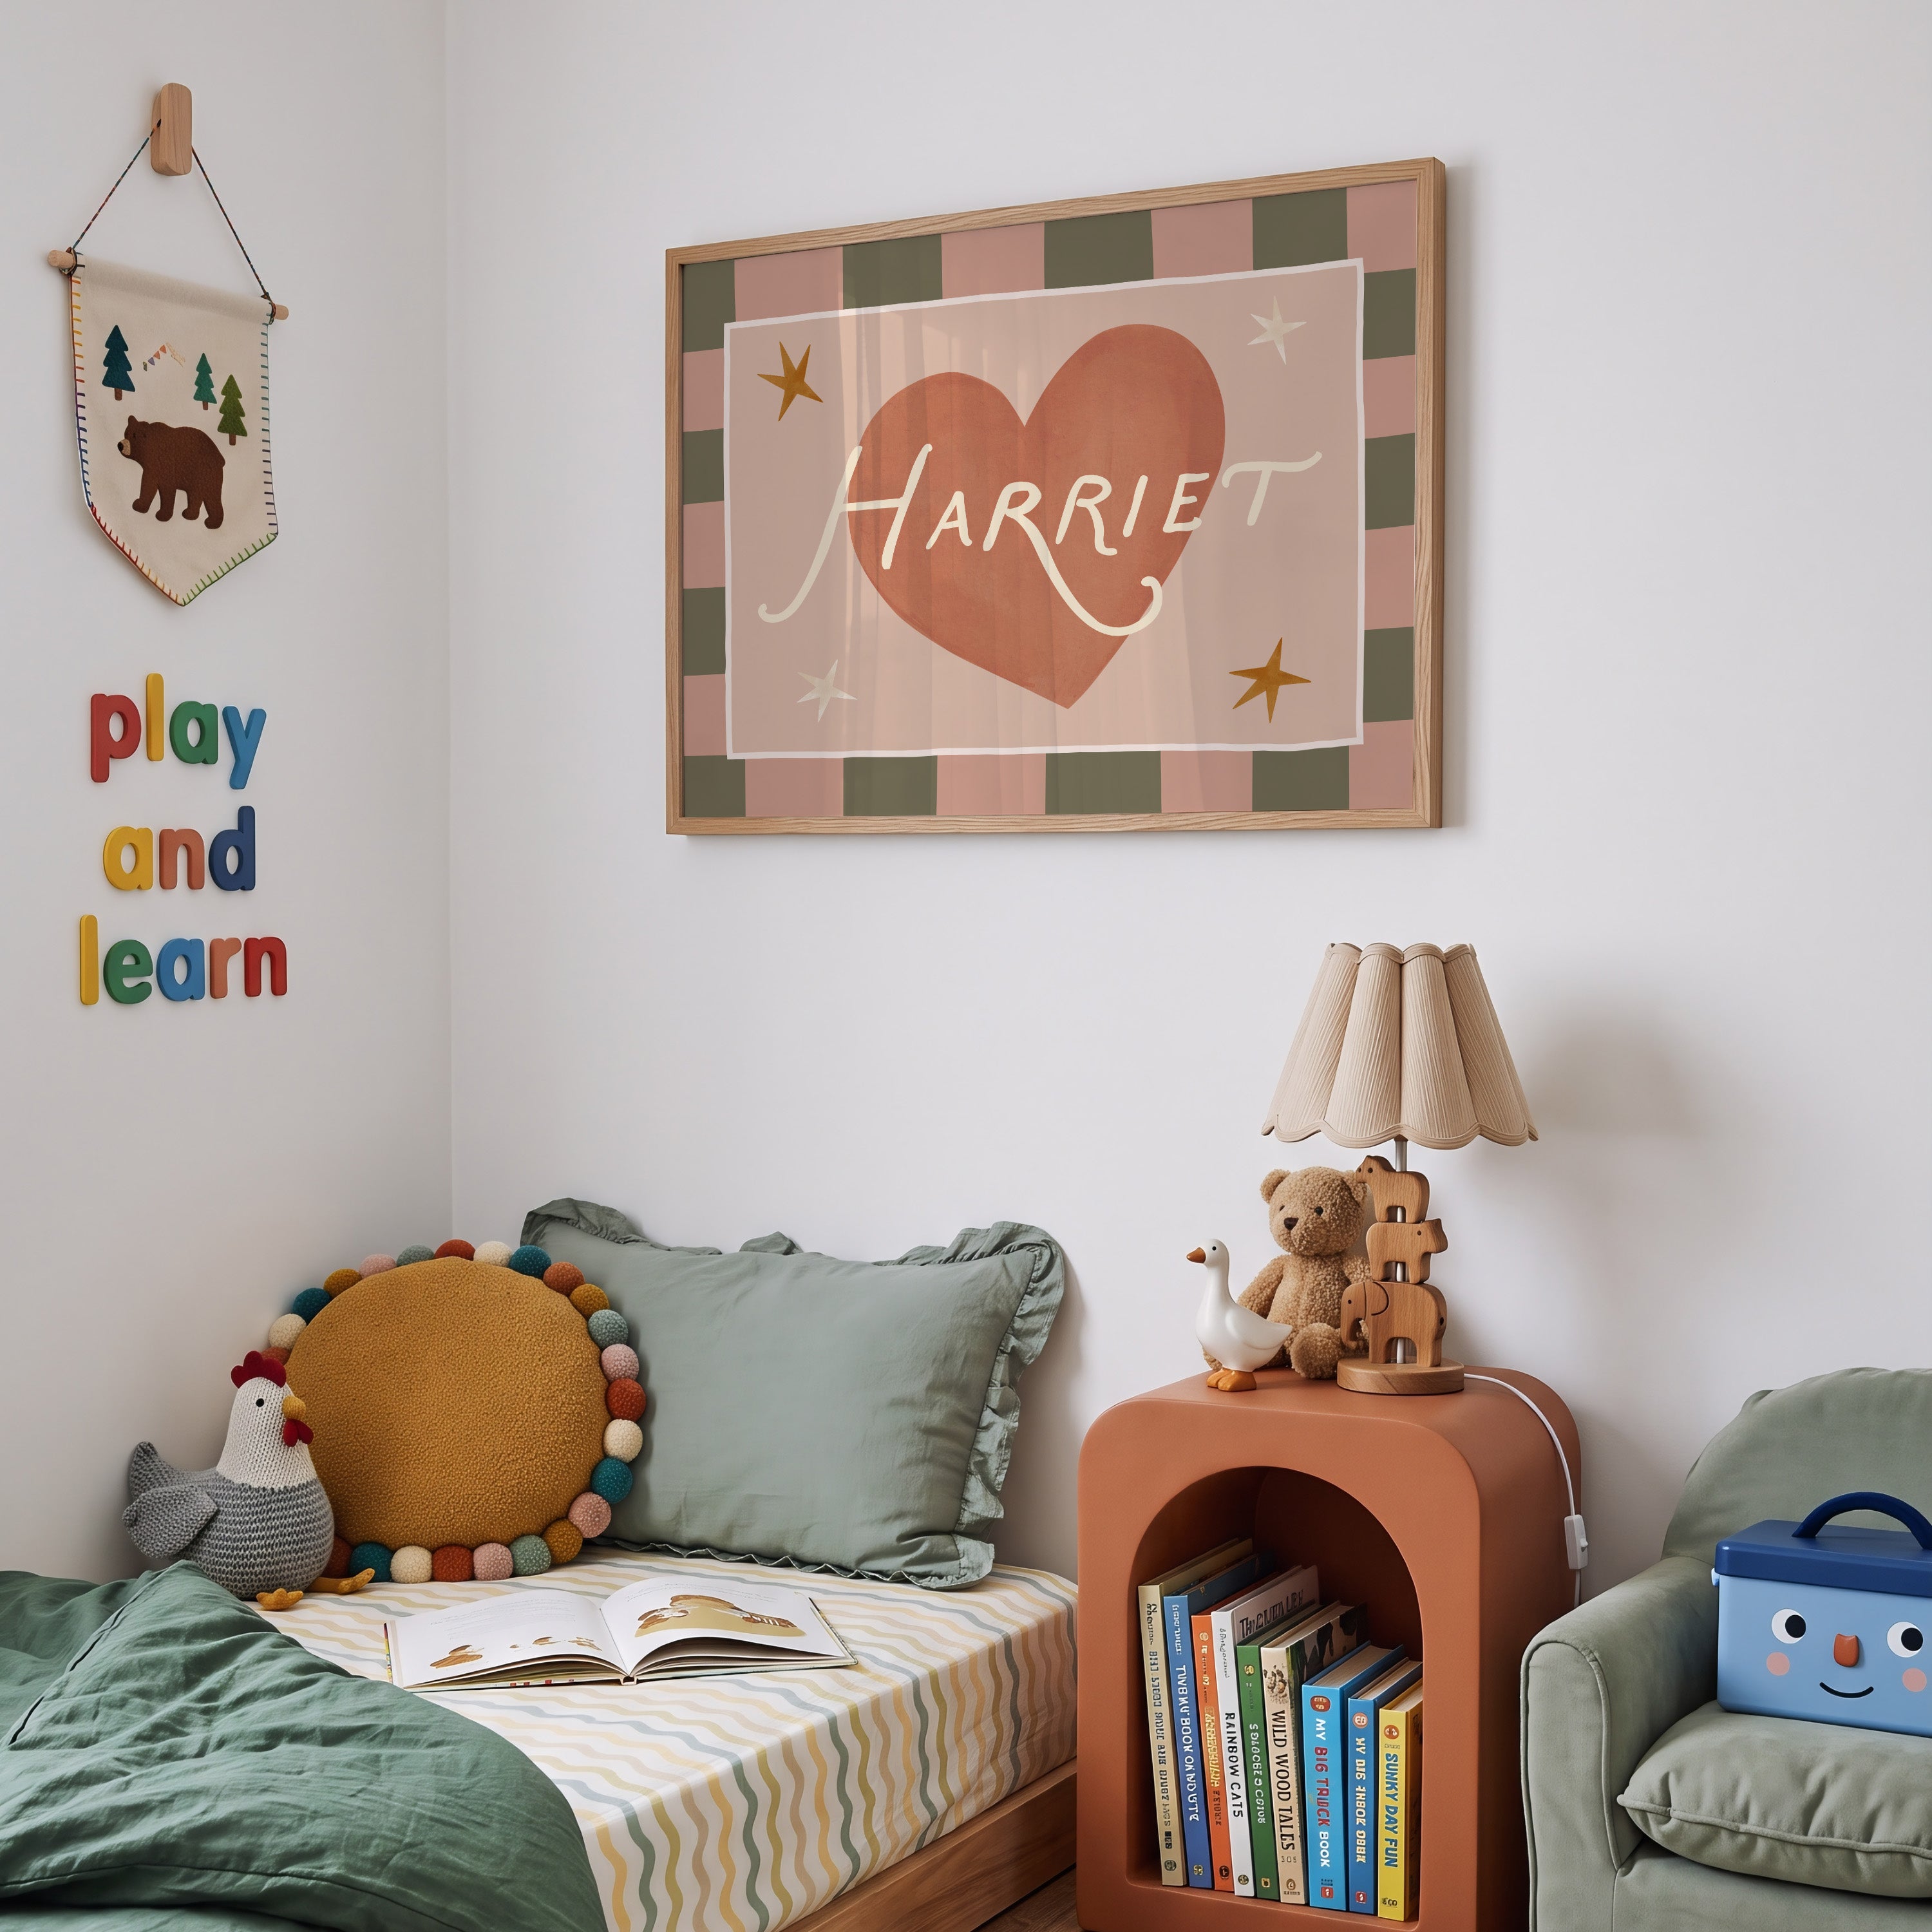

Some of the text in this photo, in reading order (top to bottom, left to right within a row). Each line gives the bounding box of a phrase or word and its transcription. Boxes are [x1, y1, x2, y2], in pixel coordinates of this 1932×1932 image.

[757, 443, 1322, 637] HARRIET
[90, 673, 267, 790] play
[103, 806, 256, 891] and
[80, 914, 288, 1006] learn
[1225, 1712, 1244, 1818] RAINBOW CATS
[1314, 1746, 1329, 1772] BIG
[1316, 1718, 1327, 1740] MY
[1271, 1710, 1295, 1850] WILD WOOD TALES
[1385, 1804, 1399, 1834] DAY
[1319, 1831, 1331, 1867] BOOK
[1384, 1838, 1399, 1868] FUN
